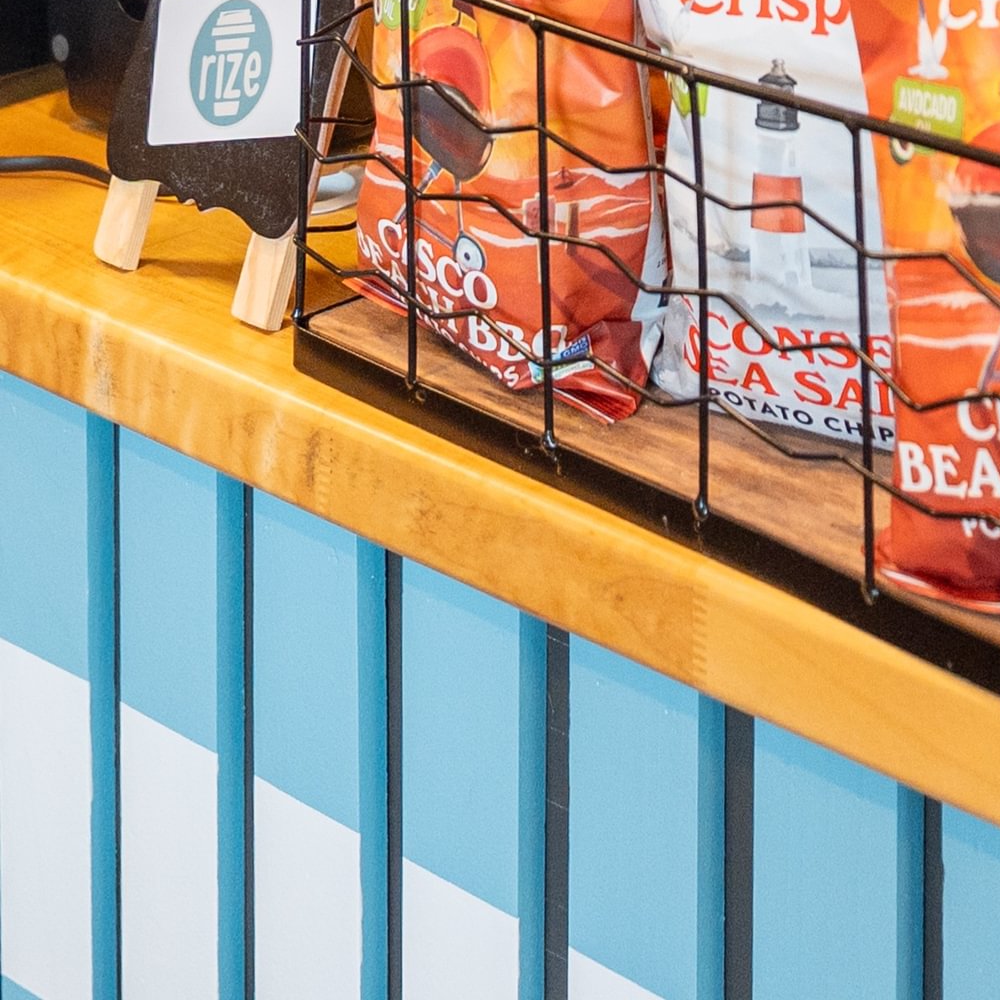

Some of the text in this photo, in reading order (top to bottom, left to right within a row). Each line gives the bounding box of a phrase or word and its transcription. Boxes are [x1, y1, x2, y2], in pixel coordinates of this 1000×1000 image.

[199, 50, 262, 101] rize
[898, 86, 957, 123] AVOCADO
[377, 218, 498, 310] CISCO
[824, 417, 894, 442] CHP
